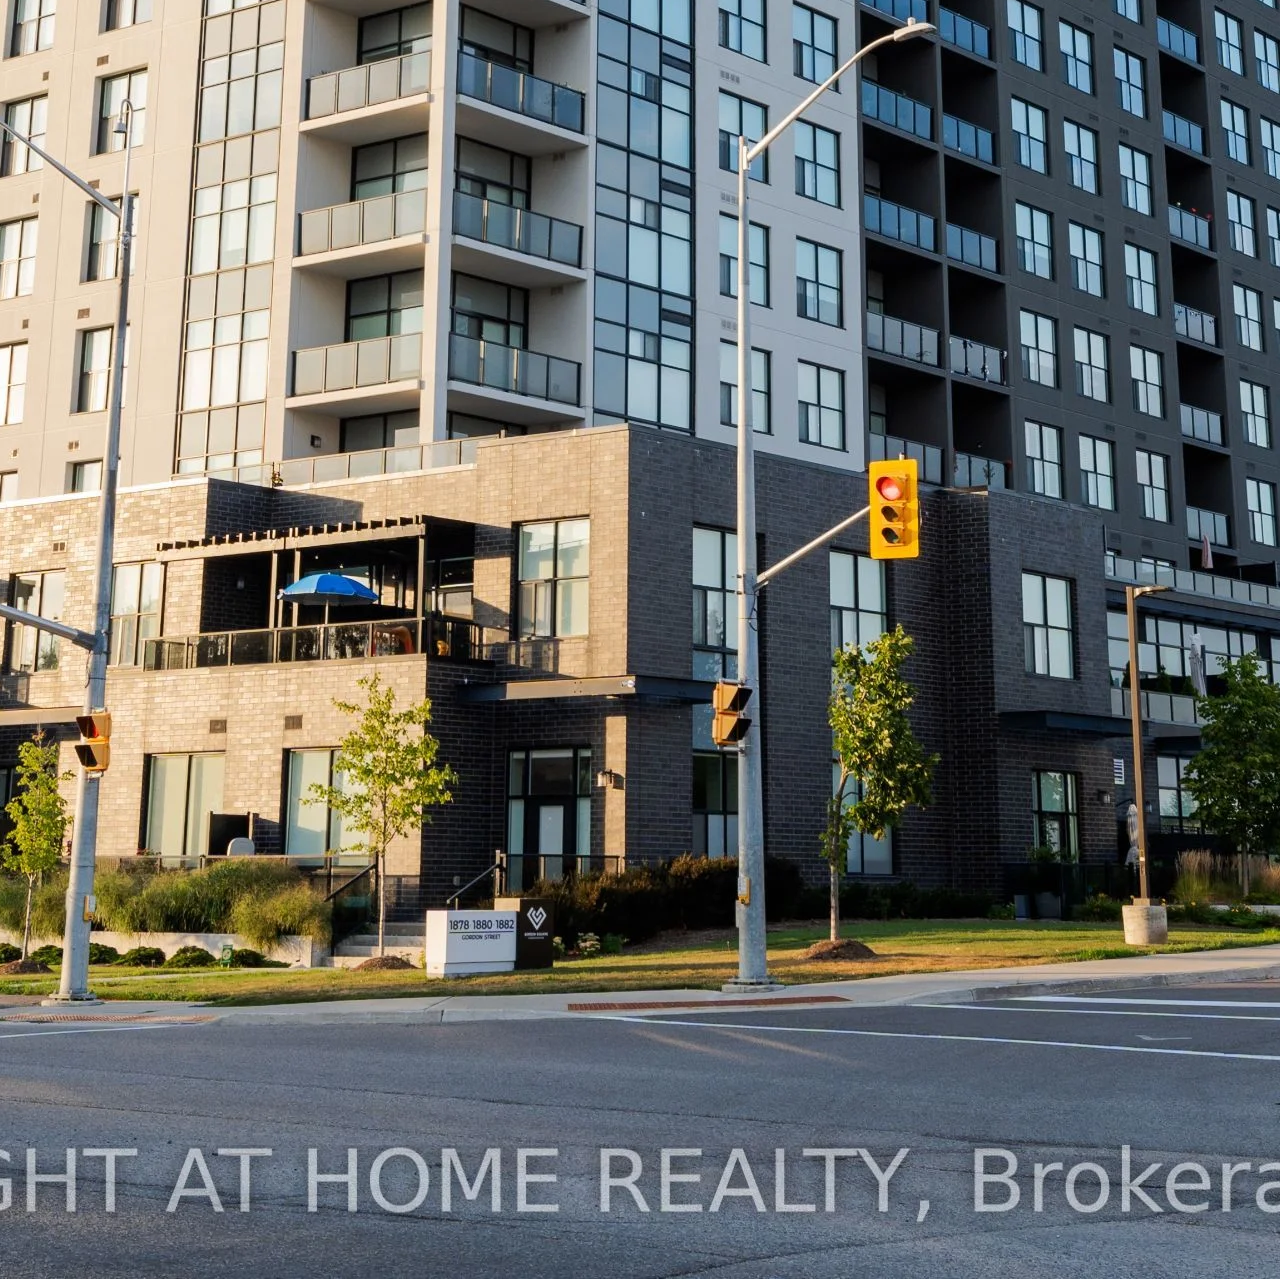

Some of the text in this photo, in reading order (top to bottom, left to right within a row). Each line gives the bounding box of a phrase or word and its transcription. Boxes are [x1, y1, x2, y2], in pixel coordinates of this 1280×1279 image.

[450, 919, 515, 930] 1878 1880 1882
